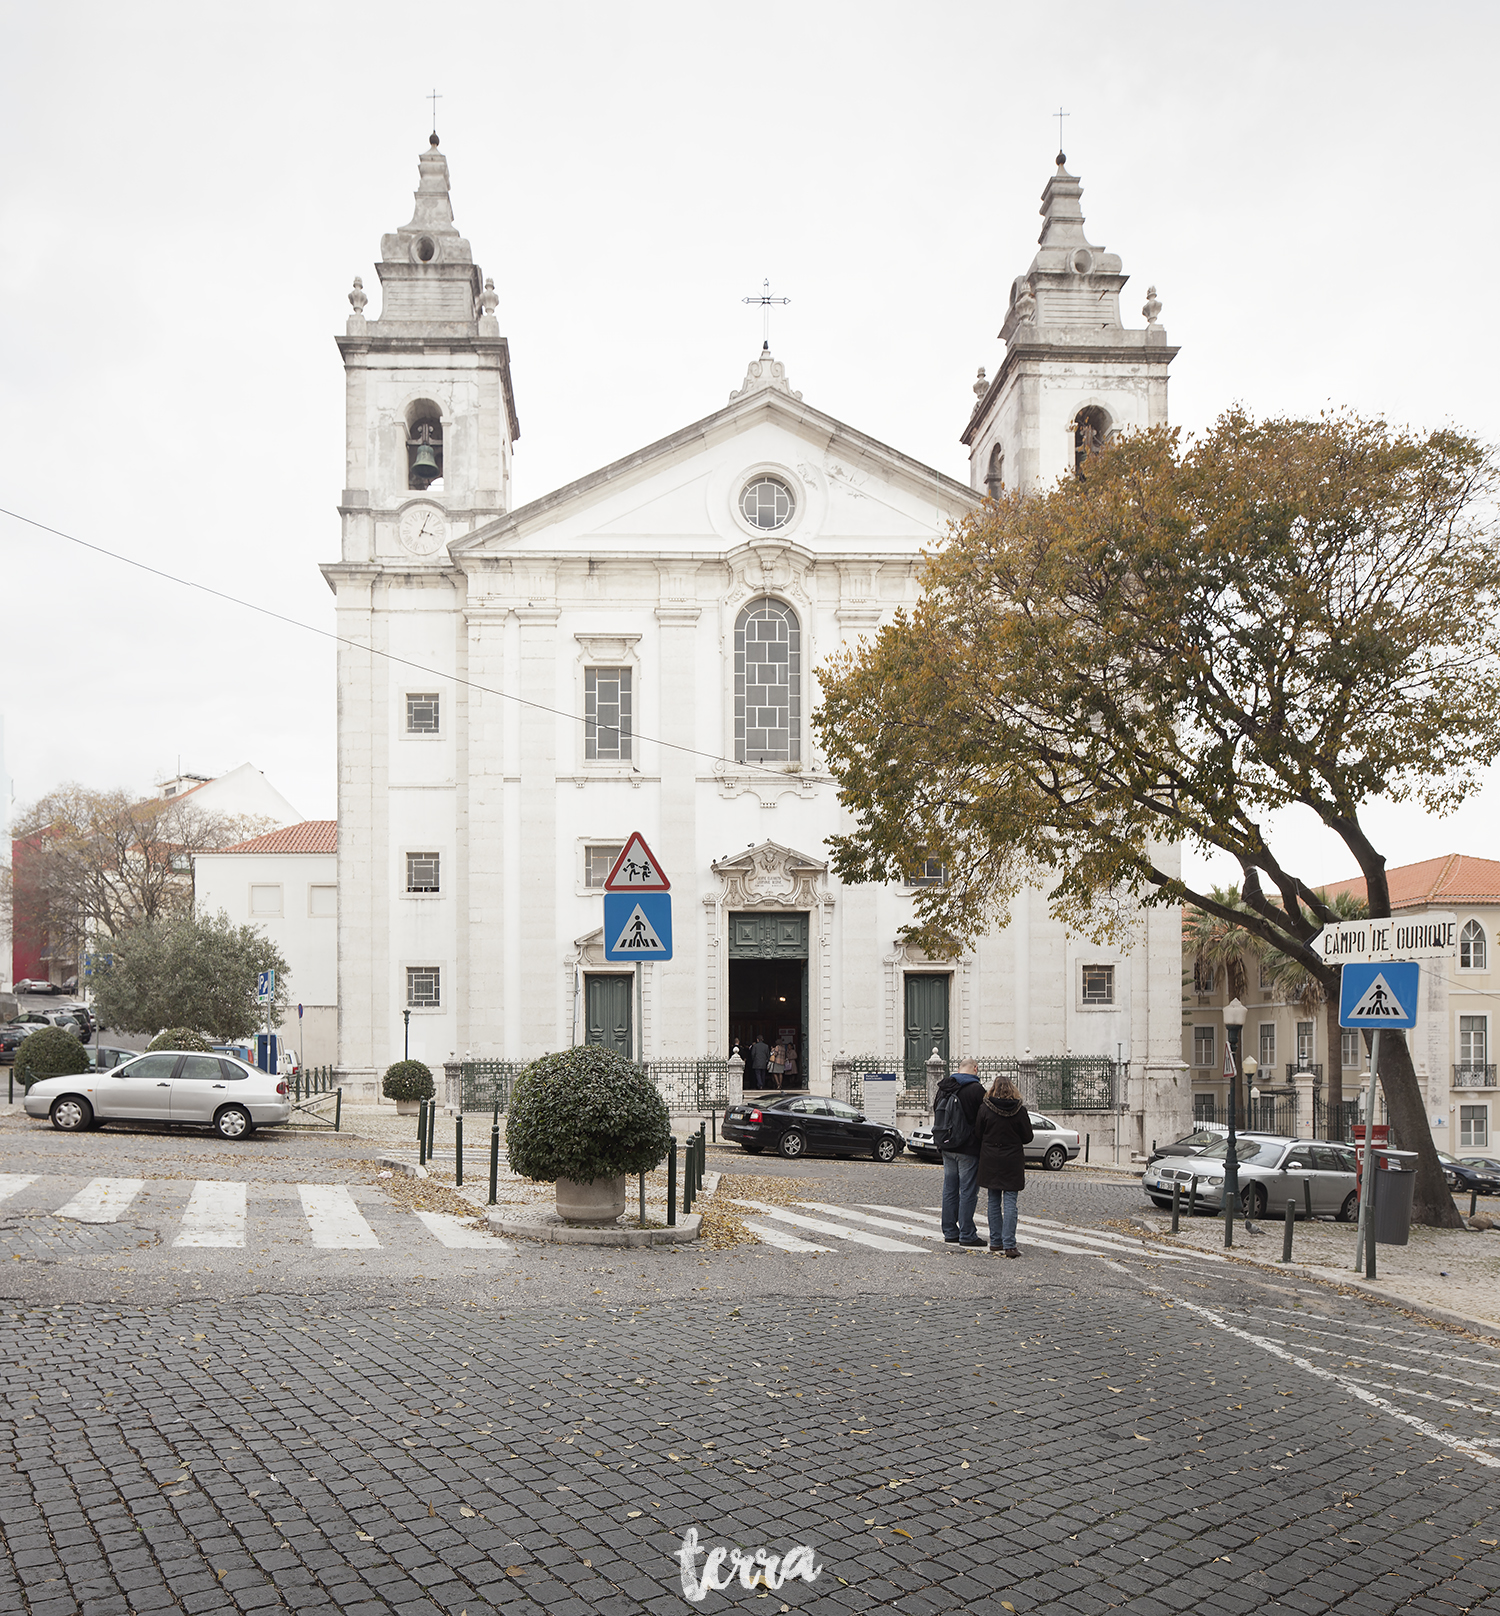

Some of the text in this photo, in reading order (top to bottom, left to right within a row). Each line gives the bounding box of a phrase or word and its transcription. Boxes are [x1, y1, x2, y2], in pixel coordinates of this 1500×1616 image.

[1325, 922, 1456, 955] CAMPO DE OURIQUE
